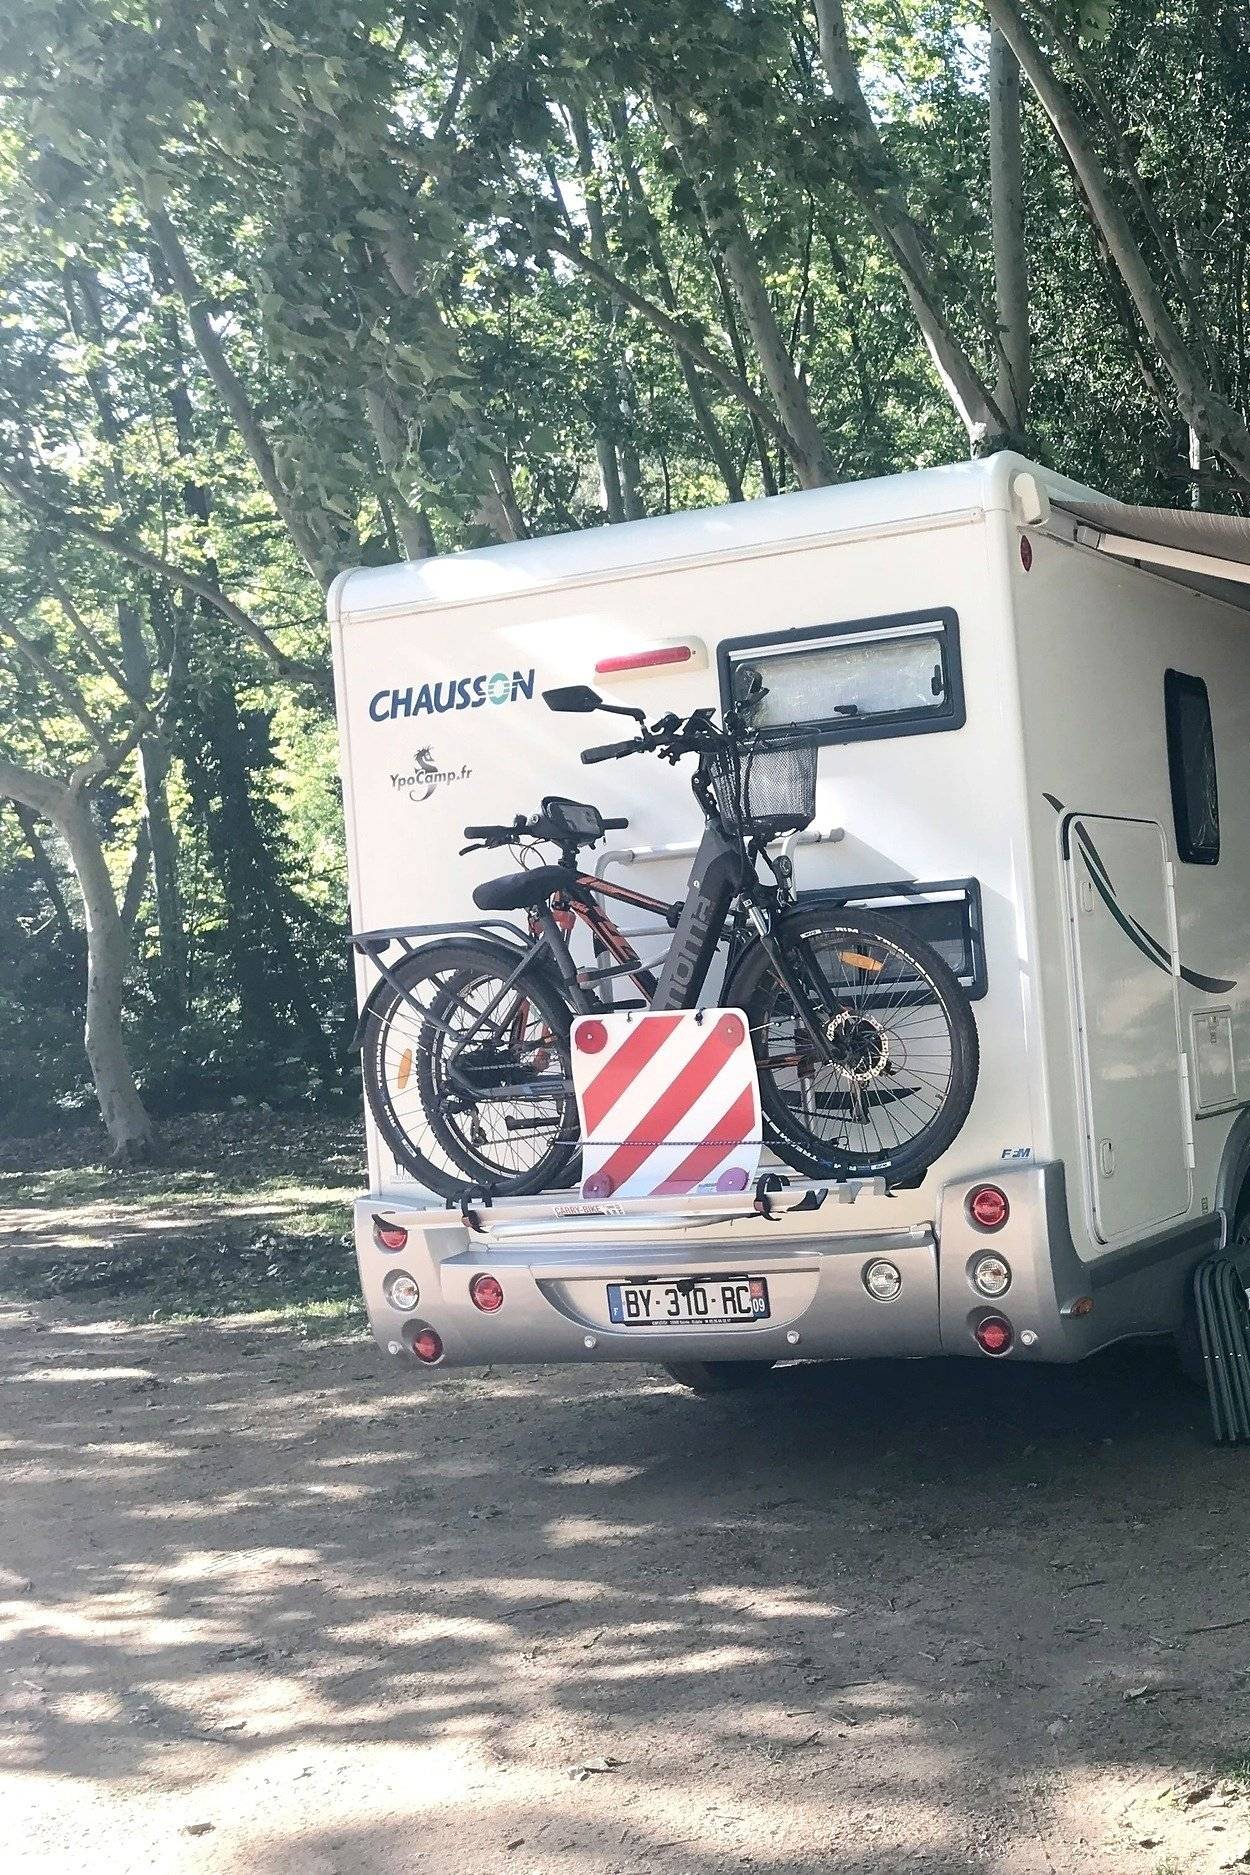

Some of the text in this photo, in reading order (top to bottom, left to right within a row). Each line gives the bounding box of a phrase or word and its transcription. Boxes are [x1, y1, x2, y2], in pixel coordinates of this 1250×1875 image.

[369, 669, 535, 722] CHAUSSON
[390, 765, 472, 790] YpoCamp.fr
[752, 1298, 765, 1313] 09
